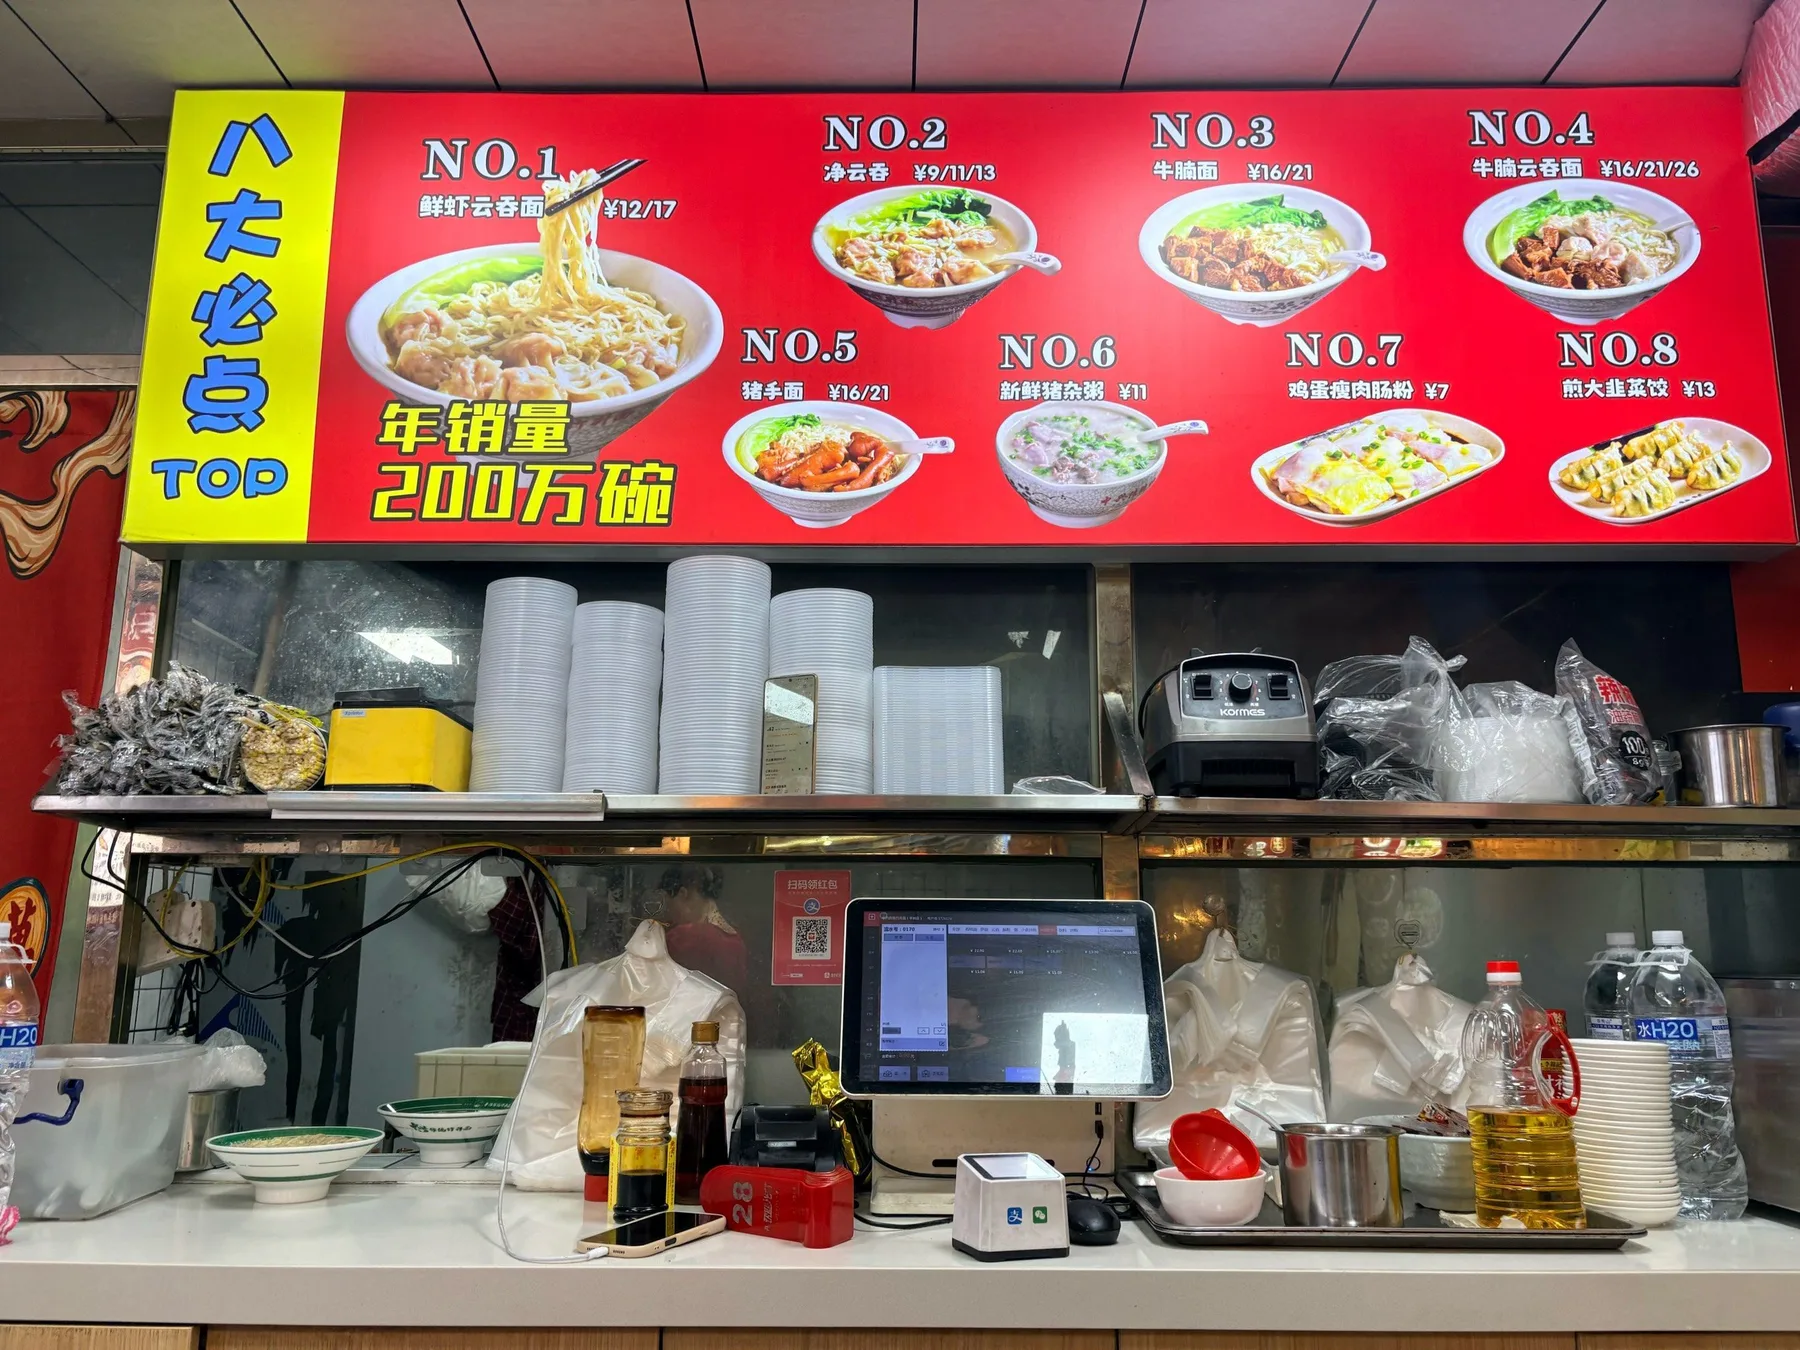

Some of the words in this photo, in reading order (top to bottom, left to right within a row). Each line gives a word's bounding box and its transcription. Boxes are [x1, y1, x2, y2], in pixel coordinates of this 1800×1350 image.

[822, 114, 948, 151] NO.2
[1150, 111, 1275, 148] NO.3
[1467, 109, 1596, 147] NO.4
[420, 137, 560, 181] NO.1
[823, 162, 890, 182] 净云吞
[913, 164, 997, 183] ¥9/11/13
[1153, 160, 1218, 181] 牛腩面
[1247, 163, 1313, 181] ¥16/21
[1472, 157, 1583, 179] 牛腩云吞面
[1599, 160, 1700, 179] ¥16/21/26
[418, 194, 545, 219] 鲜虾云吞面
[602, 199, 678, 220] ¥12/17
[182, 112, 293, 434] 八大必点
[741, 328, 858, 363] NO.5
[998, 333, 1117, 370] NO.6
[1285, 331, 1404, 367] NO.7
[1556, 331, 1679, 367] NO.8
[741, 381, 804, 401] 猪手面
[828, 384, 890, 401] ¥16/21
[999, 380, 1105, 401] 新鲜猪杂粥
[1118, 383, 1148, 401] ¥11
[1288, 380, 1415, 400] 鸡蛋瘦肉肠粉
[1424, 382, 1451, 400] ¥7
[1562, 378, 1670, 398] 煎大韭菜饺
[1681, 380, 1717, 398] ¥13
[375, 399, 574, 456] 年销量
[151, 457, 288, 500] TOP
[370, 459, 678, 527] 200万碗
[787, 879, 838, 890] 扫码领红包
